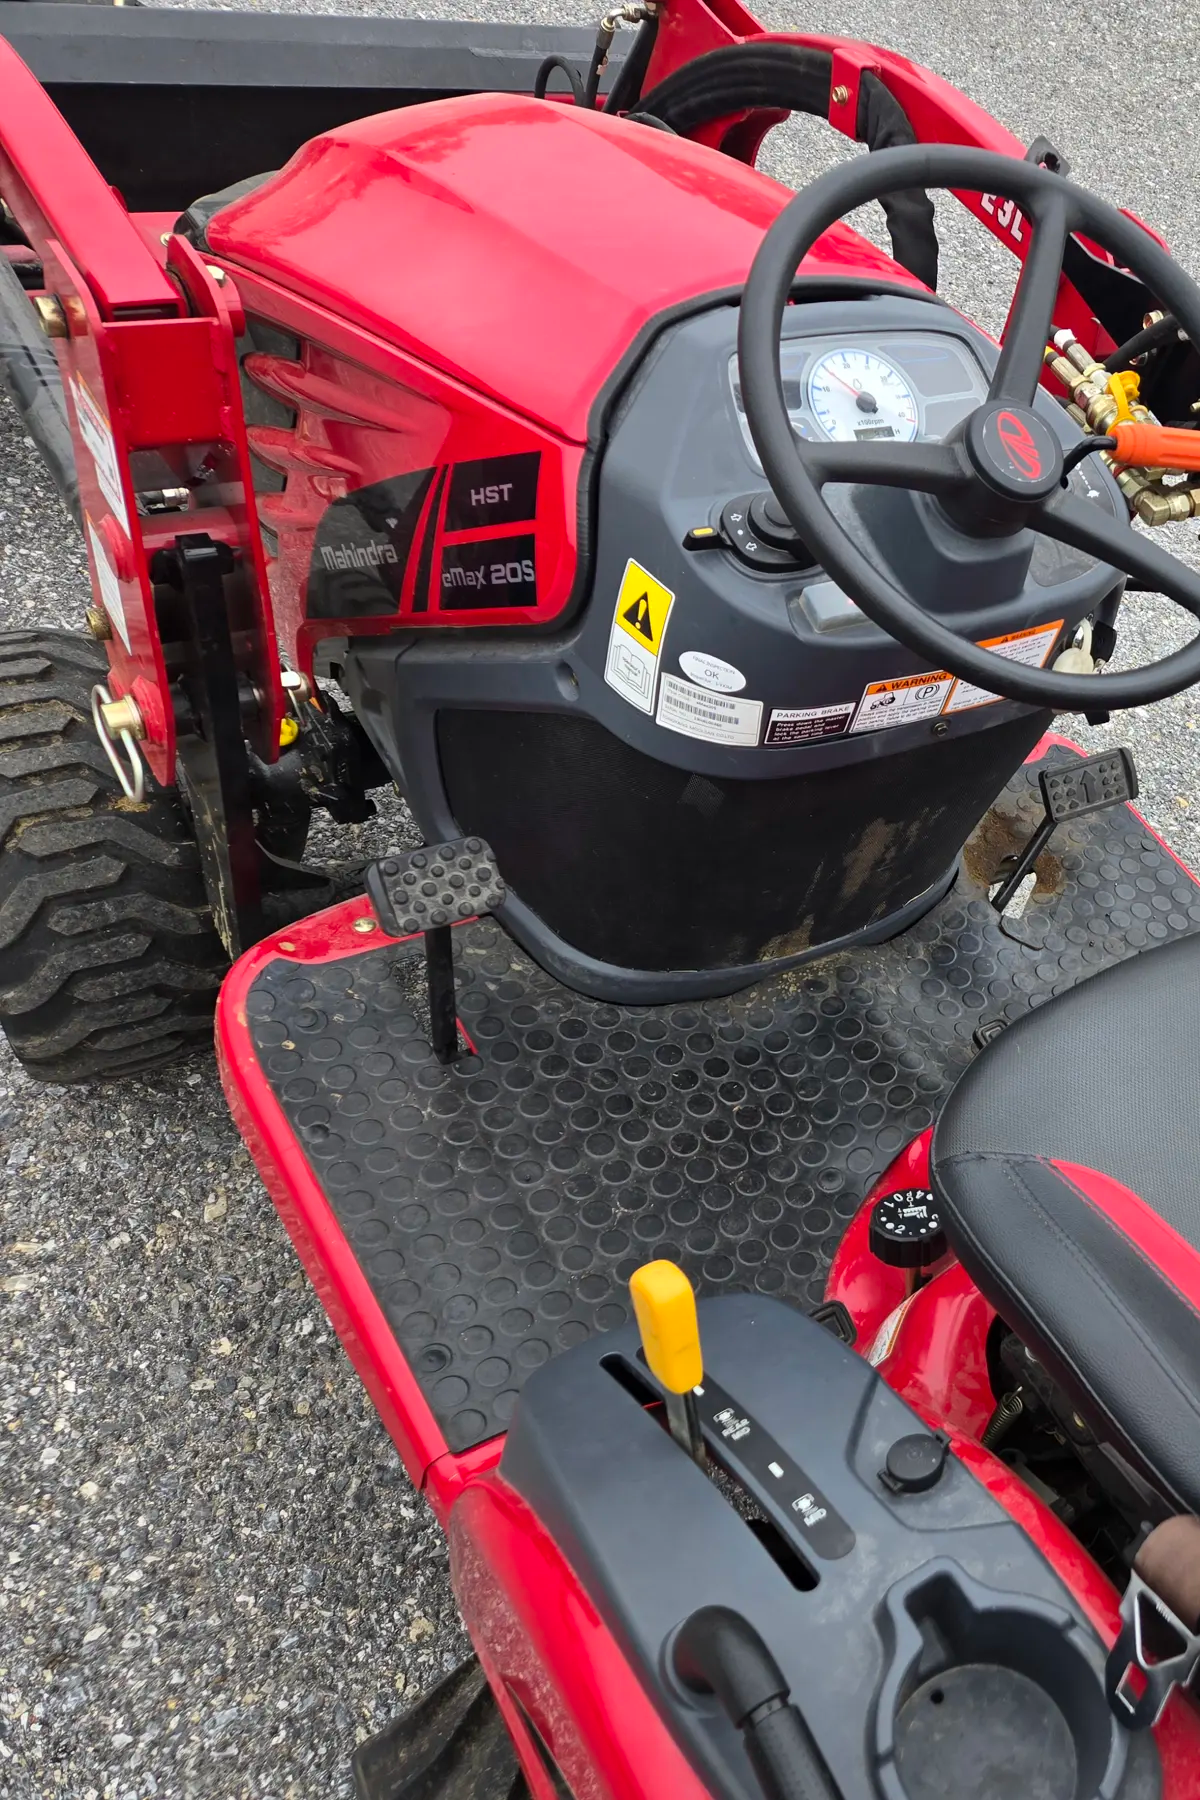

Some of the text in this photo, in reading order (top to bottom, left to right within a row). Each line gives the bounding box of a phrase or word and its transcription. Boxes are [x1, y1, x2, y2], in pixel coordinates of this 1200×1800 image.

[470, 483, 512, 506] HST
[320, 540, 398, 571] Mahindra
[442, 560, 535, 590] eMax 20S
[704, 669, 719, 679] OK
[891, 672, 948, 689] WARNING
[776, 706, 849, 719] PARKING BRAKE
[893, 1193, 903, 1202] 0
[916, 1190, 924, 1199] 4
[894, 1224, 905, 1234] 2
